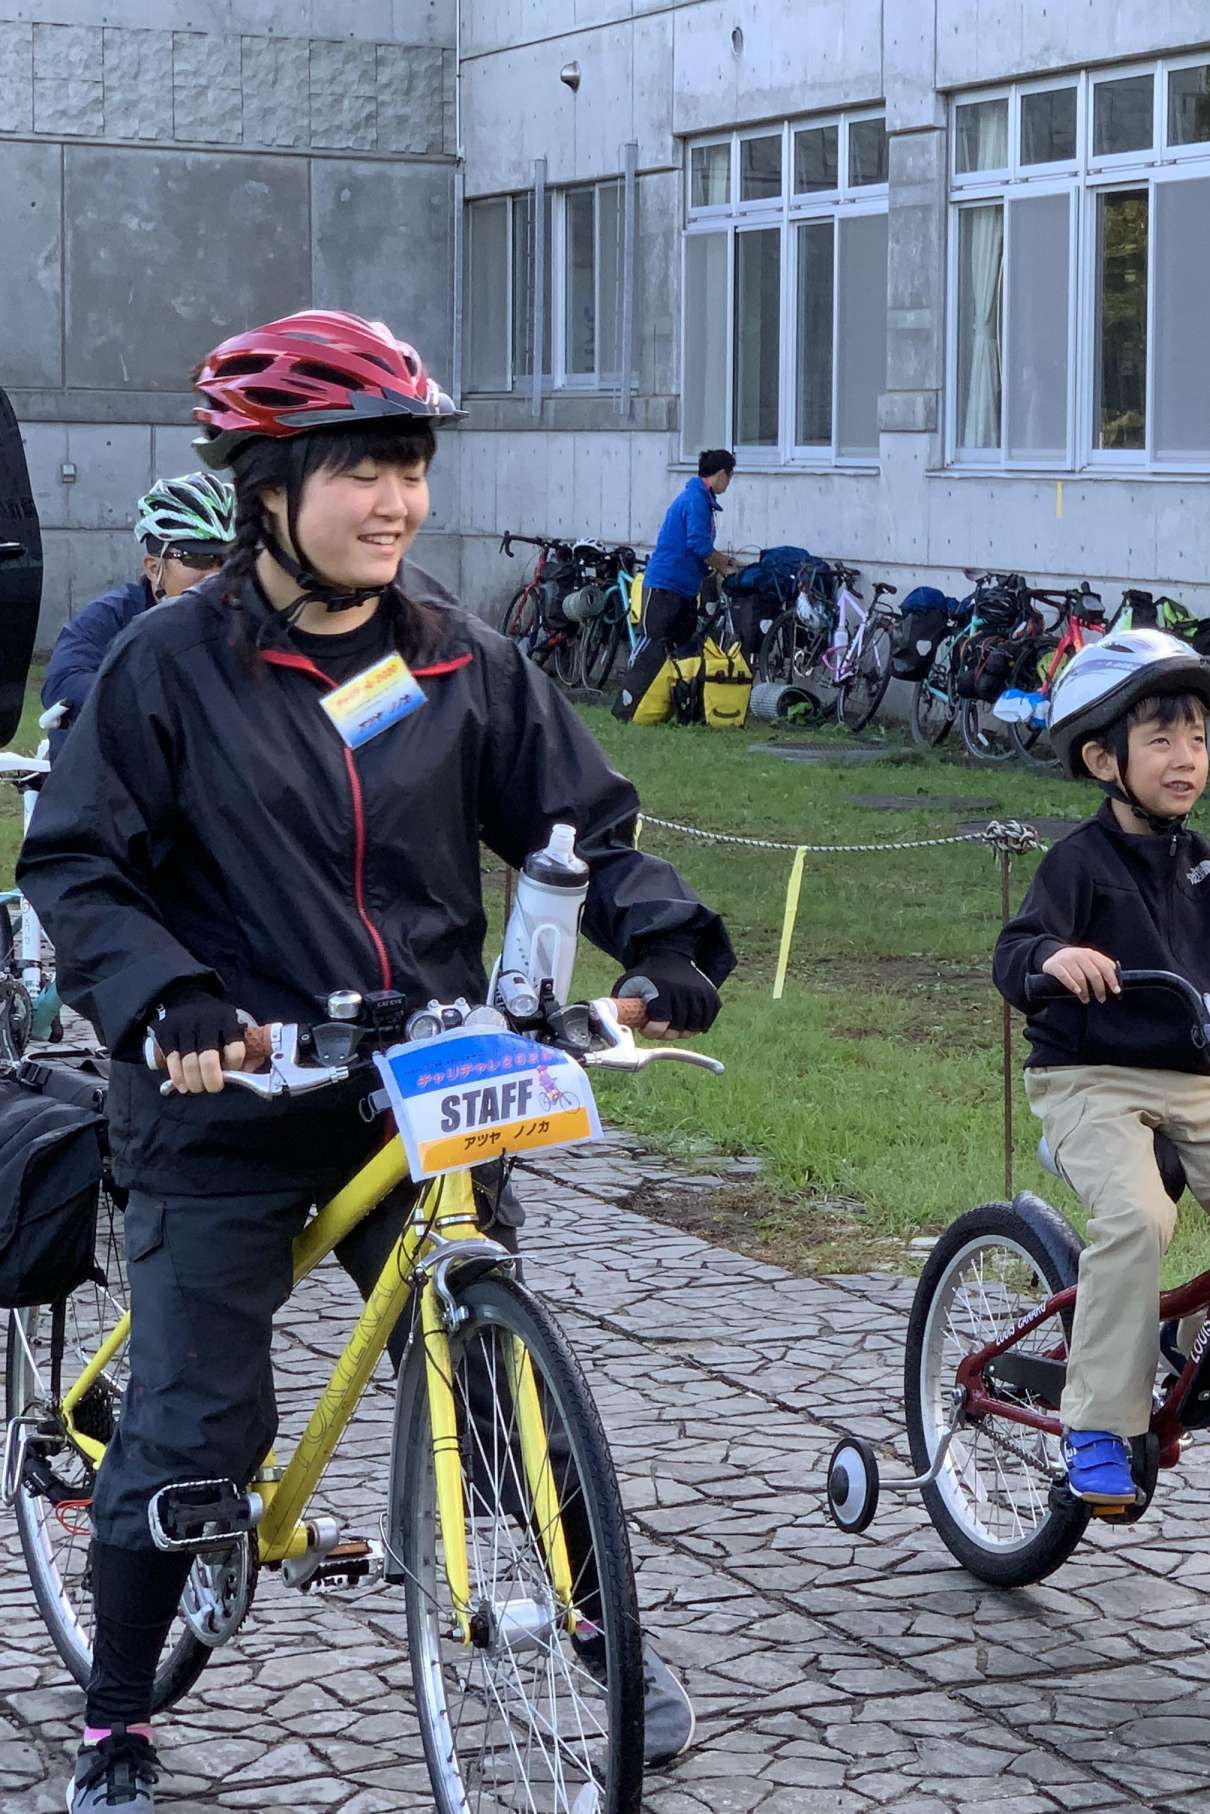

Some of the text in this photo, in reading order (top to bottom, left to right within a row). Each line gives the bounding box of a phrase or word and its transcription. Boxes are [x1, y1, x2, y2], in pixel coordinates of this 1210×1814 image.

[441, 1079, 532, 1133] STAFF
[464, 1120, 550, 1151] アツヤ ノノカ
